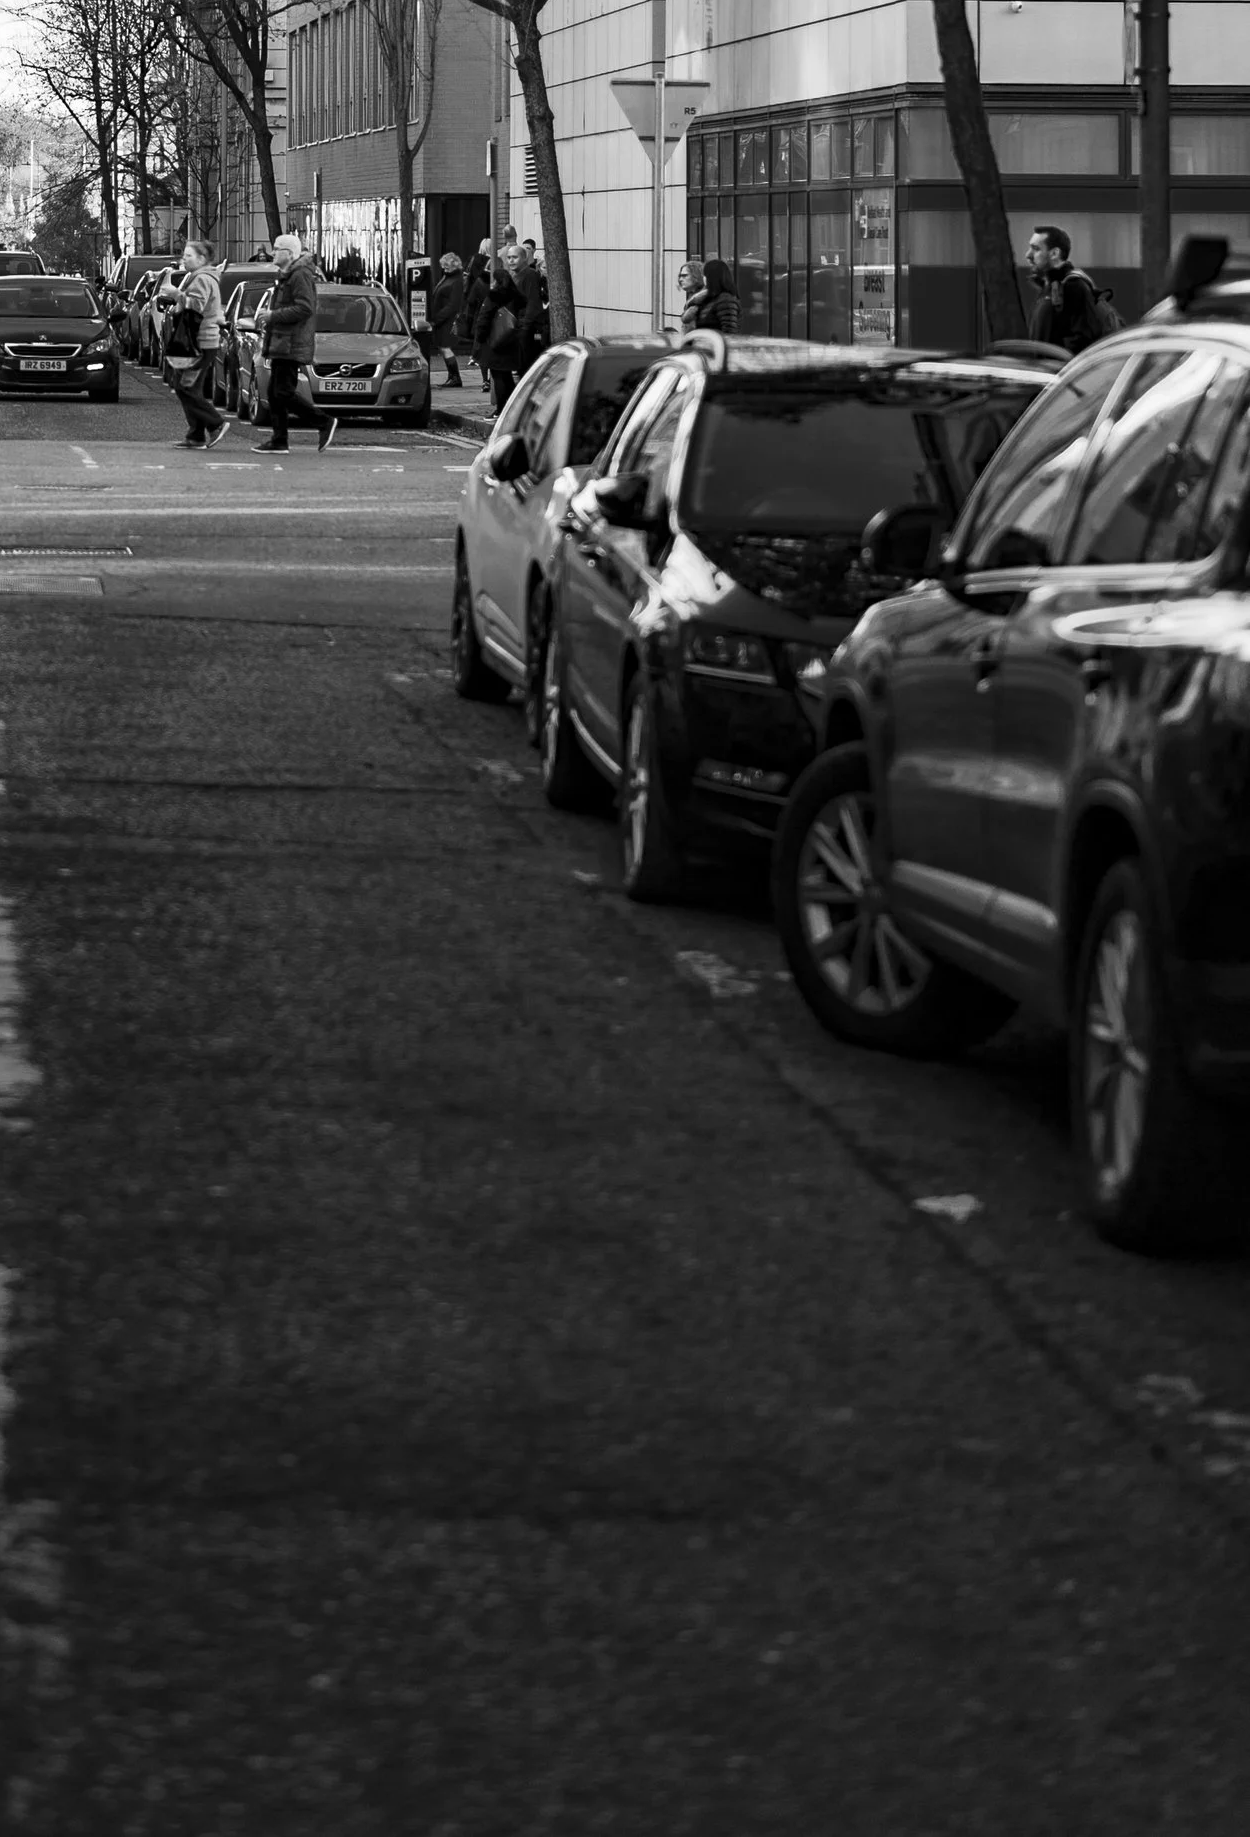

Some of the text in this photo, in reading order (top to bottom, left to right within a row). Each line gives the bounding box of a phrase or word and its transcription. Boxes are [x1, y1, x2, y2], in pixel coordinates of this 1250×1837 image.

[684, 106, 697, 115] R5
[412, 268, 421, 282] P
[39, 361, 62, 370] 6949
[324, 381, 367, 391] ERZ 7201
